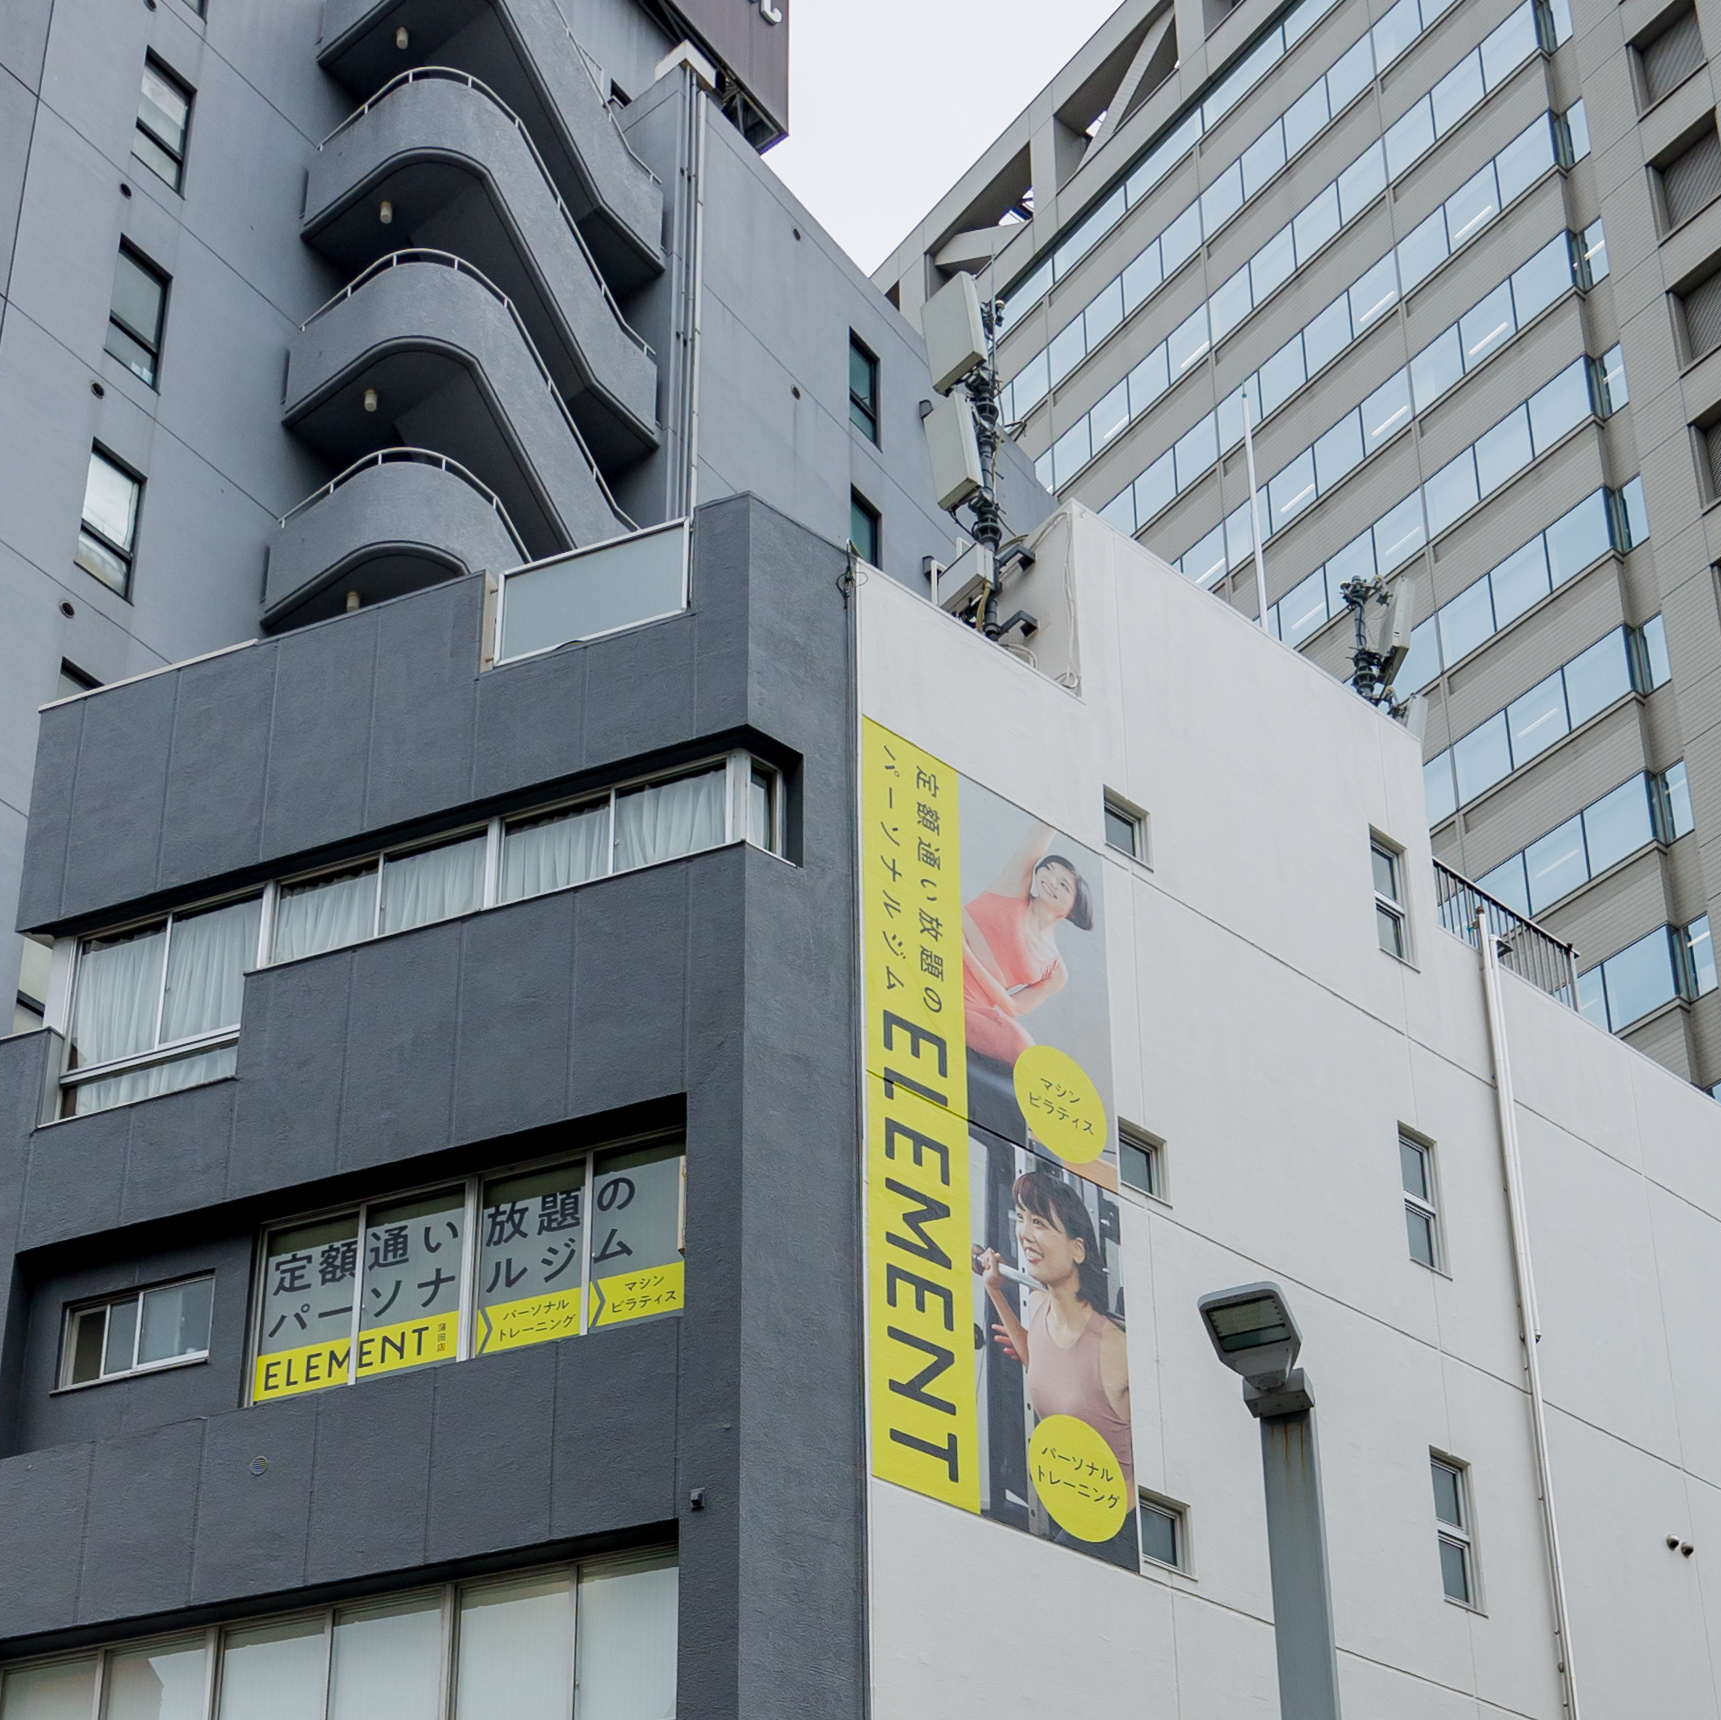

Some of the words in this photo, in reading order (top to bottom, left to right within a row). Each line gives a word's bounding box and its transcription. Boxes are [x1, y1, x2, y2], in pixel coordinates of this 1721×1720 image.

[880, 745, 907, 991] パーソナルジム
[915, 765, 944, 1014] 定額通い放題の
[1039, 1077, 1081, 1104] マシン
[1028, 1091, 1095, 1136] ピラティス
[272, 1177, 636, 1297] 定額通い放題の
[882, 1009, 960, 1484] ELEMENT
[268, 1228, 634, 1338] パーソナルジム
[611, 1290, 678, 1314] ピラティス
[624, 1275, 665, 1292] マシン
[498, 1313, 576, 1342] トレーニング
[502, 1299, 570, 1322] パーソナル
[263, 1326, 430, 1392] ELEMENT
[1037, 1464, 1121, 1510] トレーニング
[1041, 1446, 1114, 1483] パーソナル
